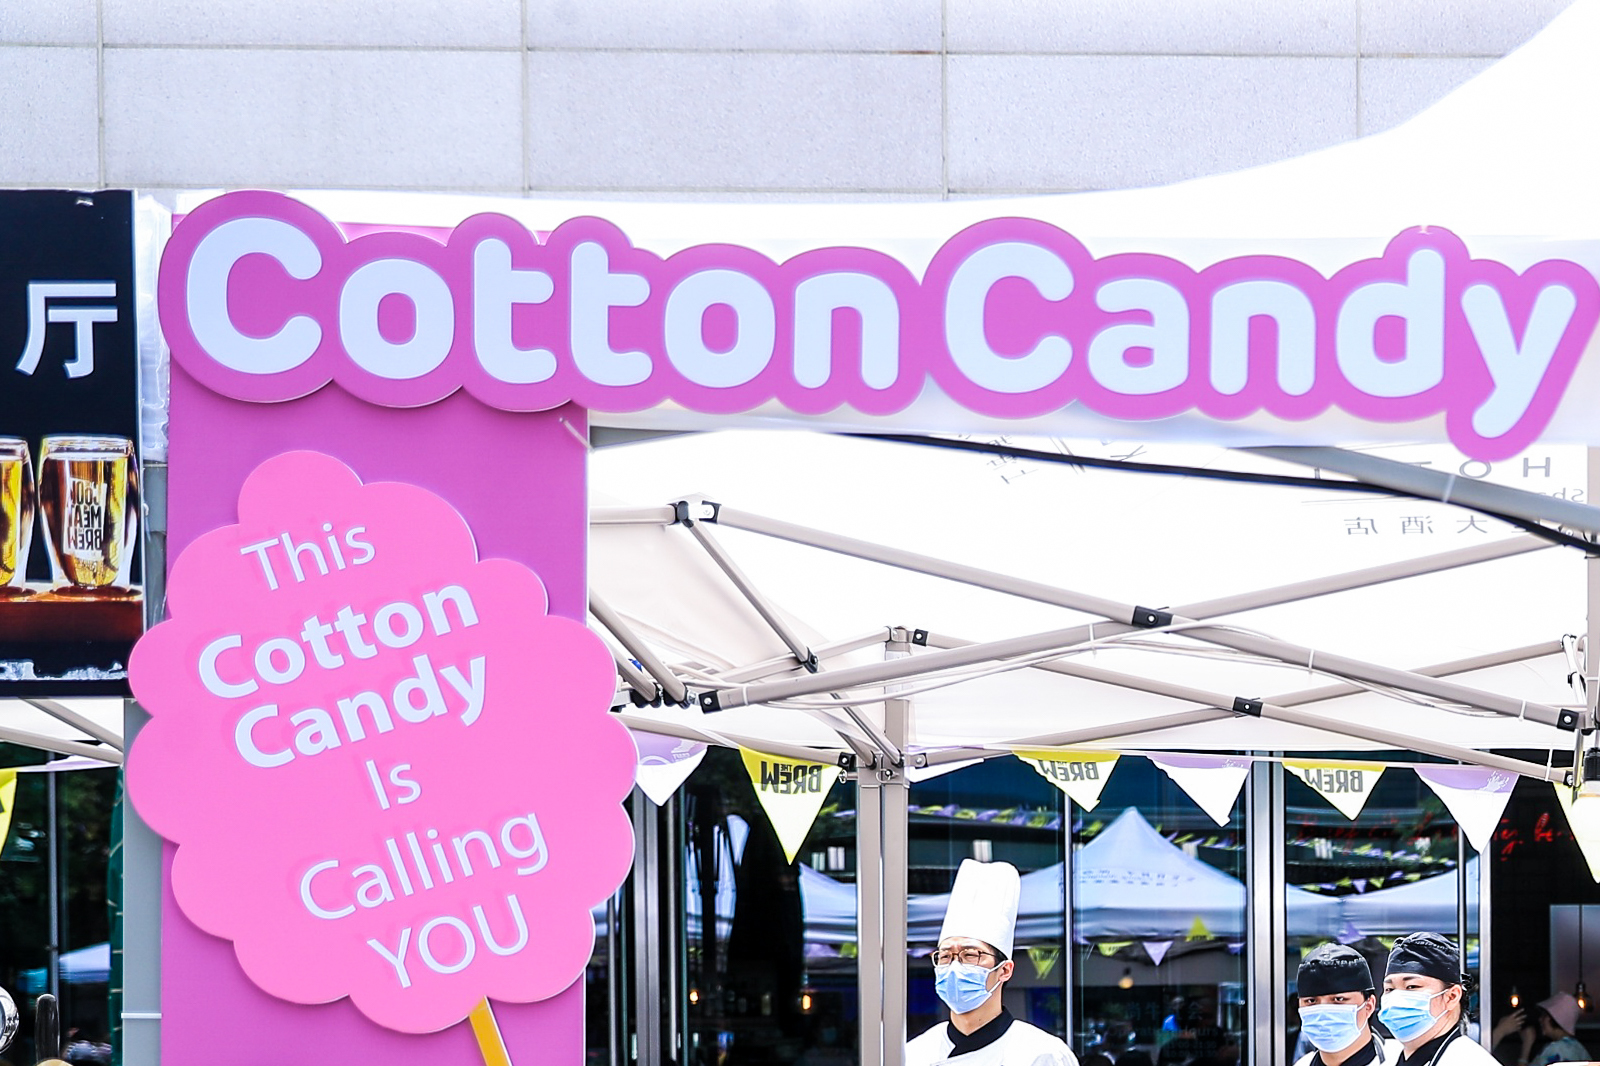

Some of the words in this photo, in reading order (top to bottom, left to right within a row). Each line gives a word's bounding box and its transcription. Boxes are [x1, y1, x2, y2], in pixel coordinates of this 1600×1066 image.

[15, 281, 118, 379] 厅
[186, 216, 900, 390] Cotton
[945, 241, 1577, 438] Candy
[240, 522, 376, 591] This
[198, 584, 479, 699] Cotton
[234, 655, 487, 768] Candy
[365, 759, 422, 810] Is
[300, 813, 549, 919] Calling
[366, 894, 529, 989] YOU
